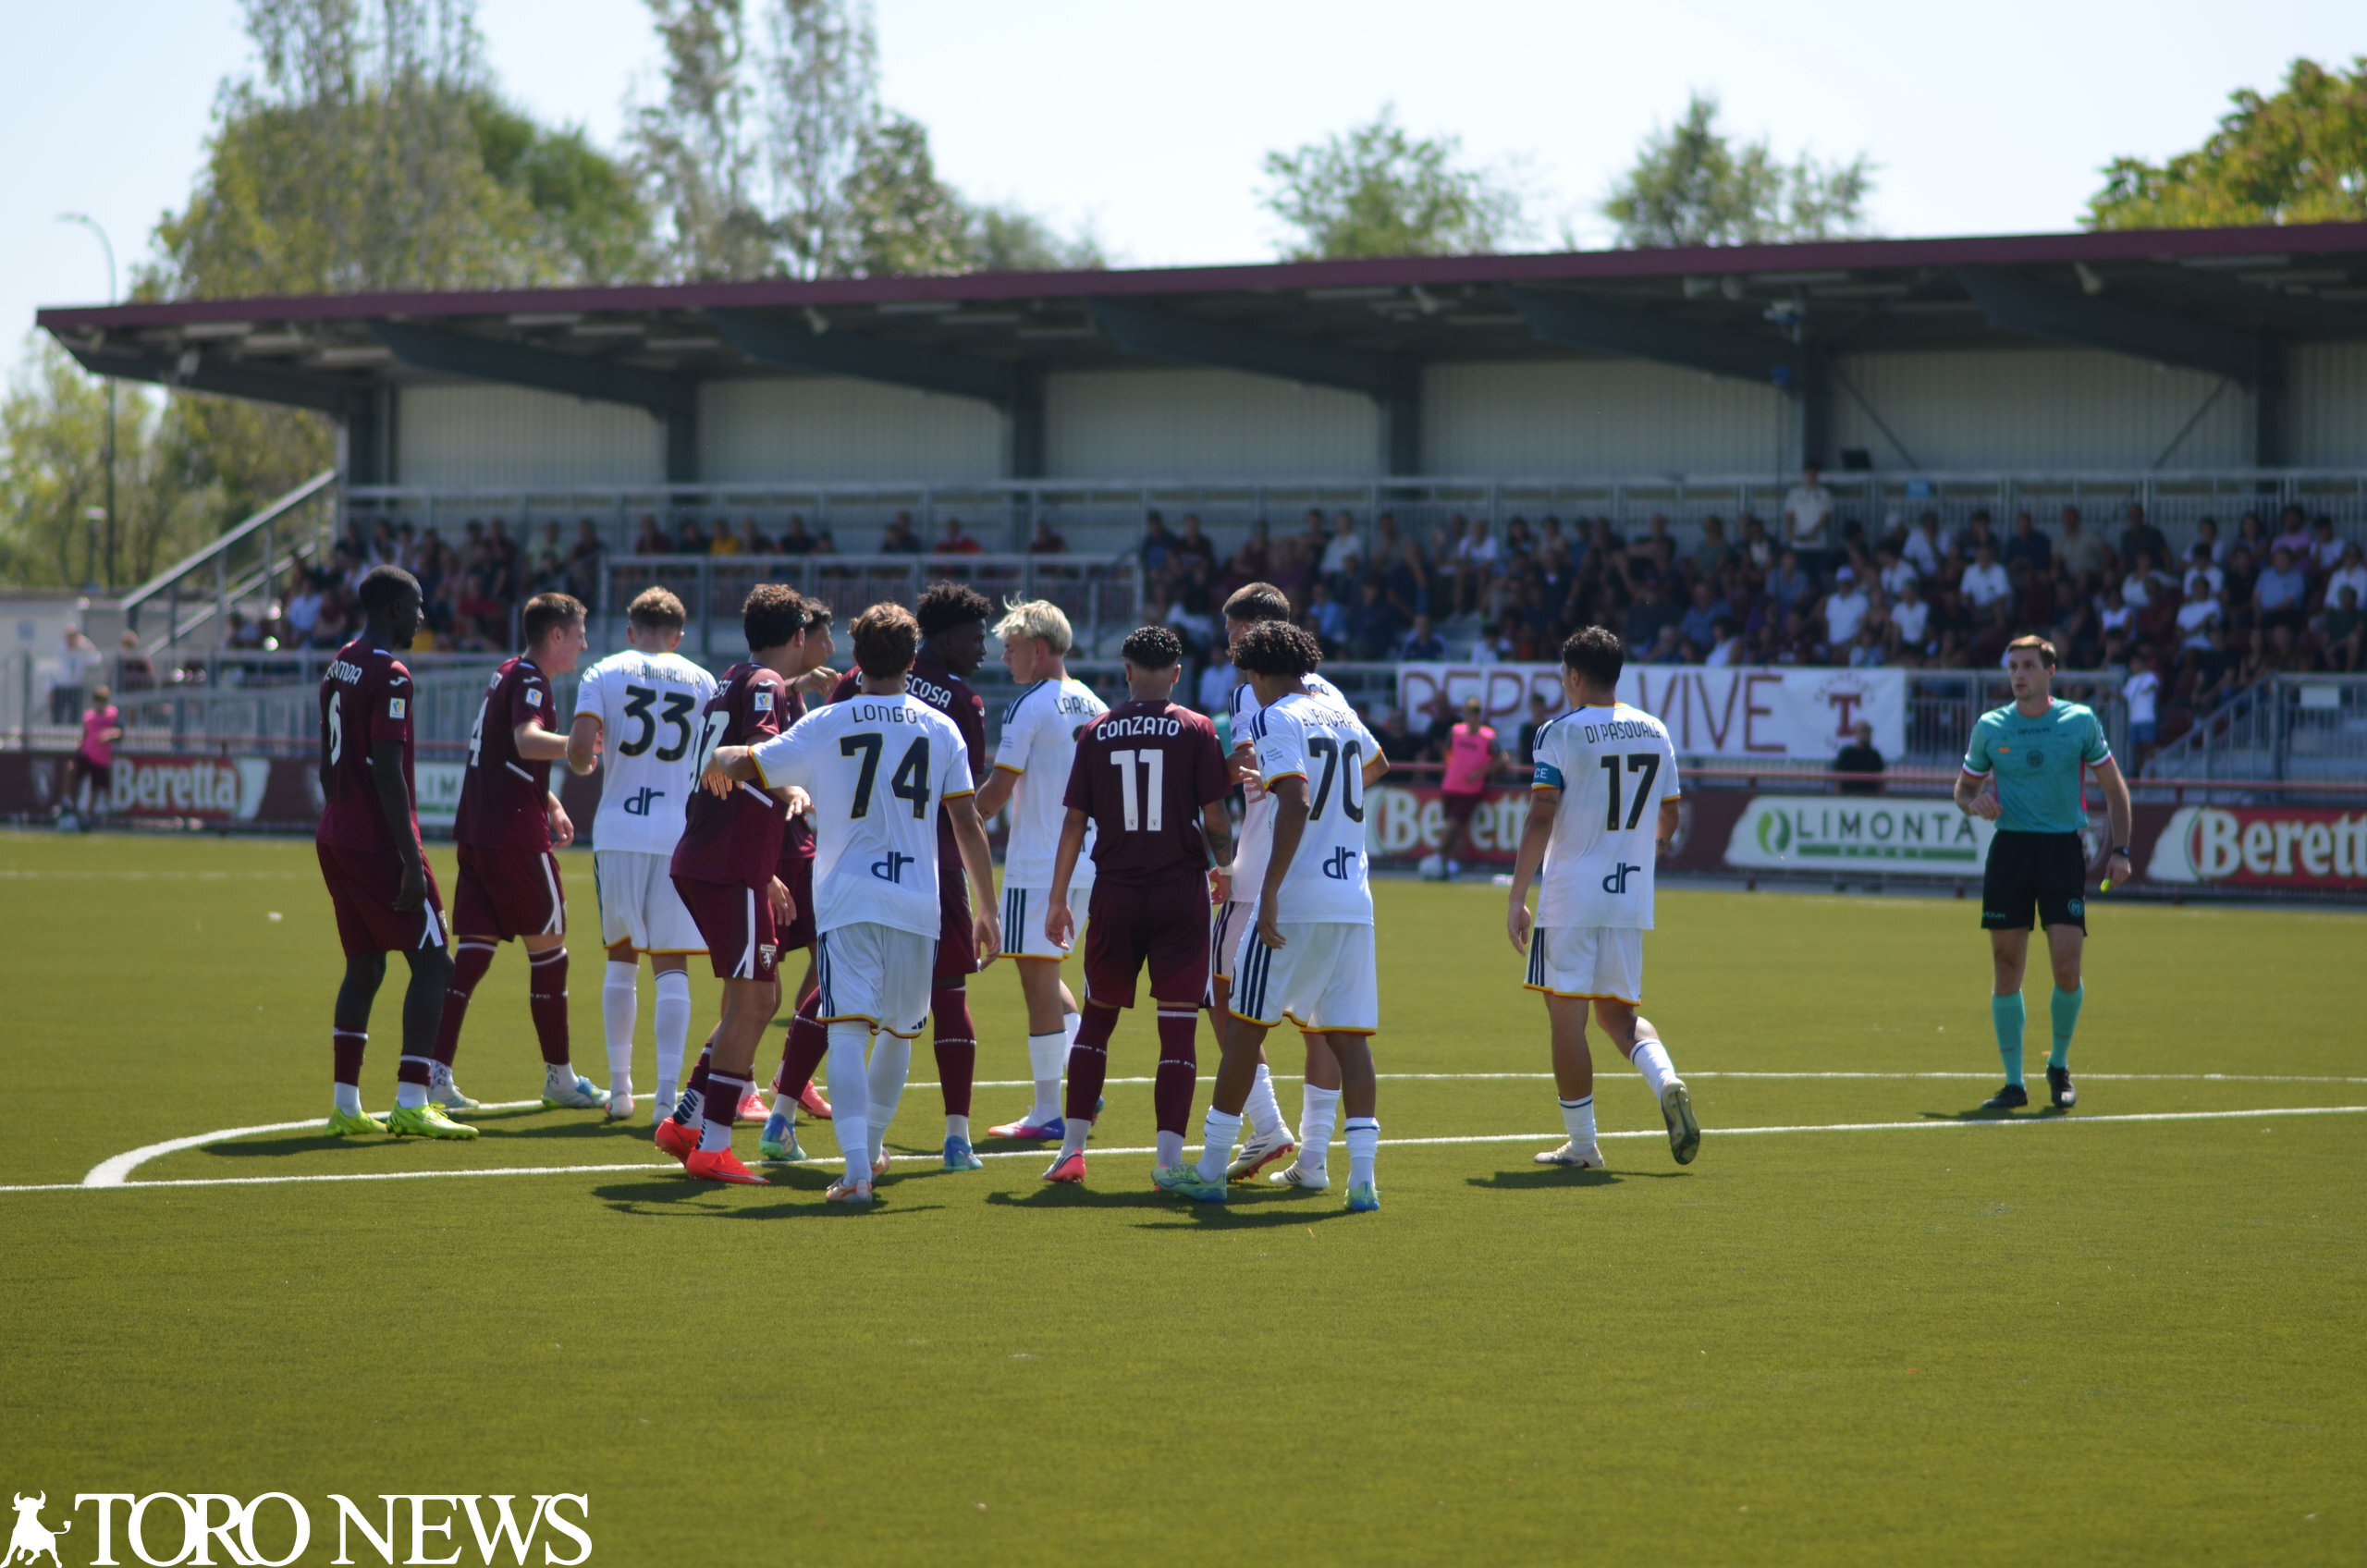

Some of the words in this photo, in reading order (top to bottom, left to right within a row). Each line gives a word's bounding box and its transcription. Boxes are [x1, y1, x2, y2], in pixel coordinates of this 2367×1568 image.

[469, 696, 488, 766] 4
[618, 684, 697, 763] 33
[852, 704, 917, 724] LONGO
[1097, 716, 1181, 741] CONZATO
[1311, 708, 1359, 729] BOURA
[1585, 725, 1600, 744] DI
[1601, 721, 1661, 741] PASQUALE
[1633, 670, 1786, 753] VIVE
[110, 757, 238, 810] Beretta
[623, 786, 666, 816] dr
[840, 732, 930, 820] 74
[1110, 749, 1163, 832] 11
[1307, 738, 1365, 823] 70
[1600, 753, 1661, 831] 17
[1383, 788, 1529, 852] Beett
[1796, 808, 1978, 843] LIMONTA
[2198, 807, 2367, 878] Berett
[871, 851, 914, 884] dr
[1322, 846, 1356, 880] dr
[1602, 863, 1641, 894] dr
